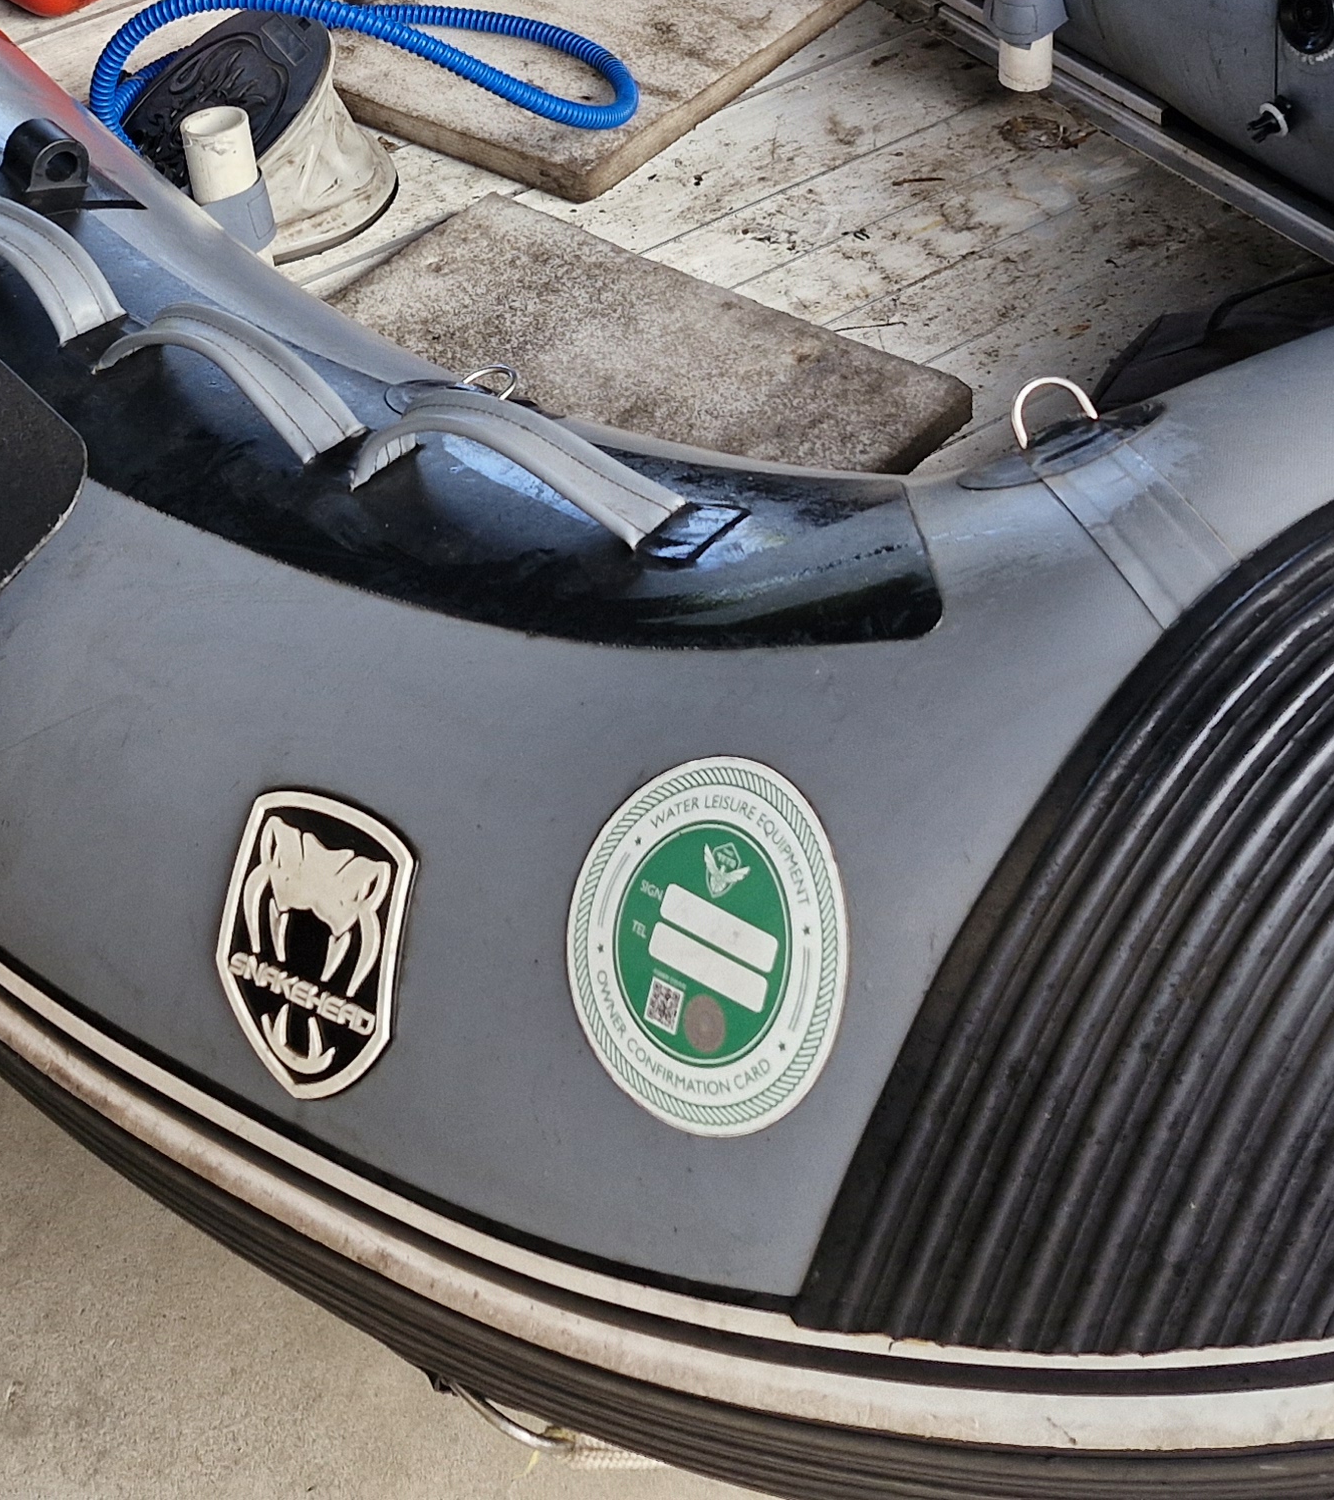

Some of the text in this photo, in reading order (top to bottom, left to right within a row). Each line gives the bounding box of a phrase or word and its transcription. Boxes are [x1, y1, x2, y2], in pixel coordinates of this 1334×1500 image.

[640, 879, 664, 901] SIGN
[650, 797, 700, 829] WATER
[704, 794, 757, 821] LEISURE
[756, 813, 810, 905] EQUIPMENT
[632, 919, 647, 939] TEL
[228, 952, 376, 1036] SNAKEHEAD
[597, 970, 771, 1096] OWNER CONFIRMATION CARD
